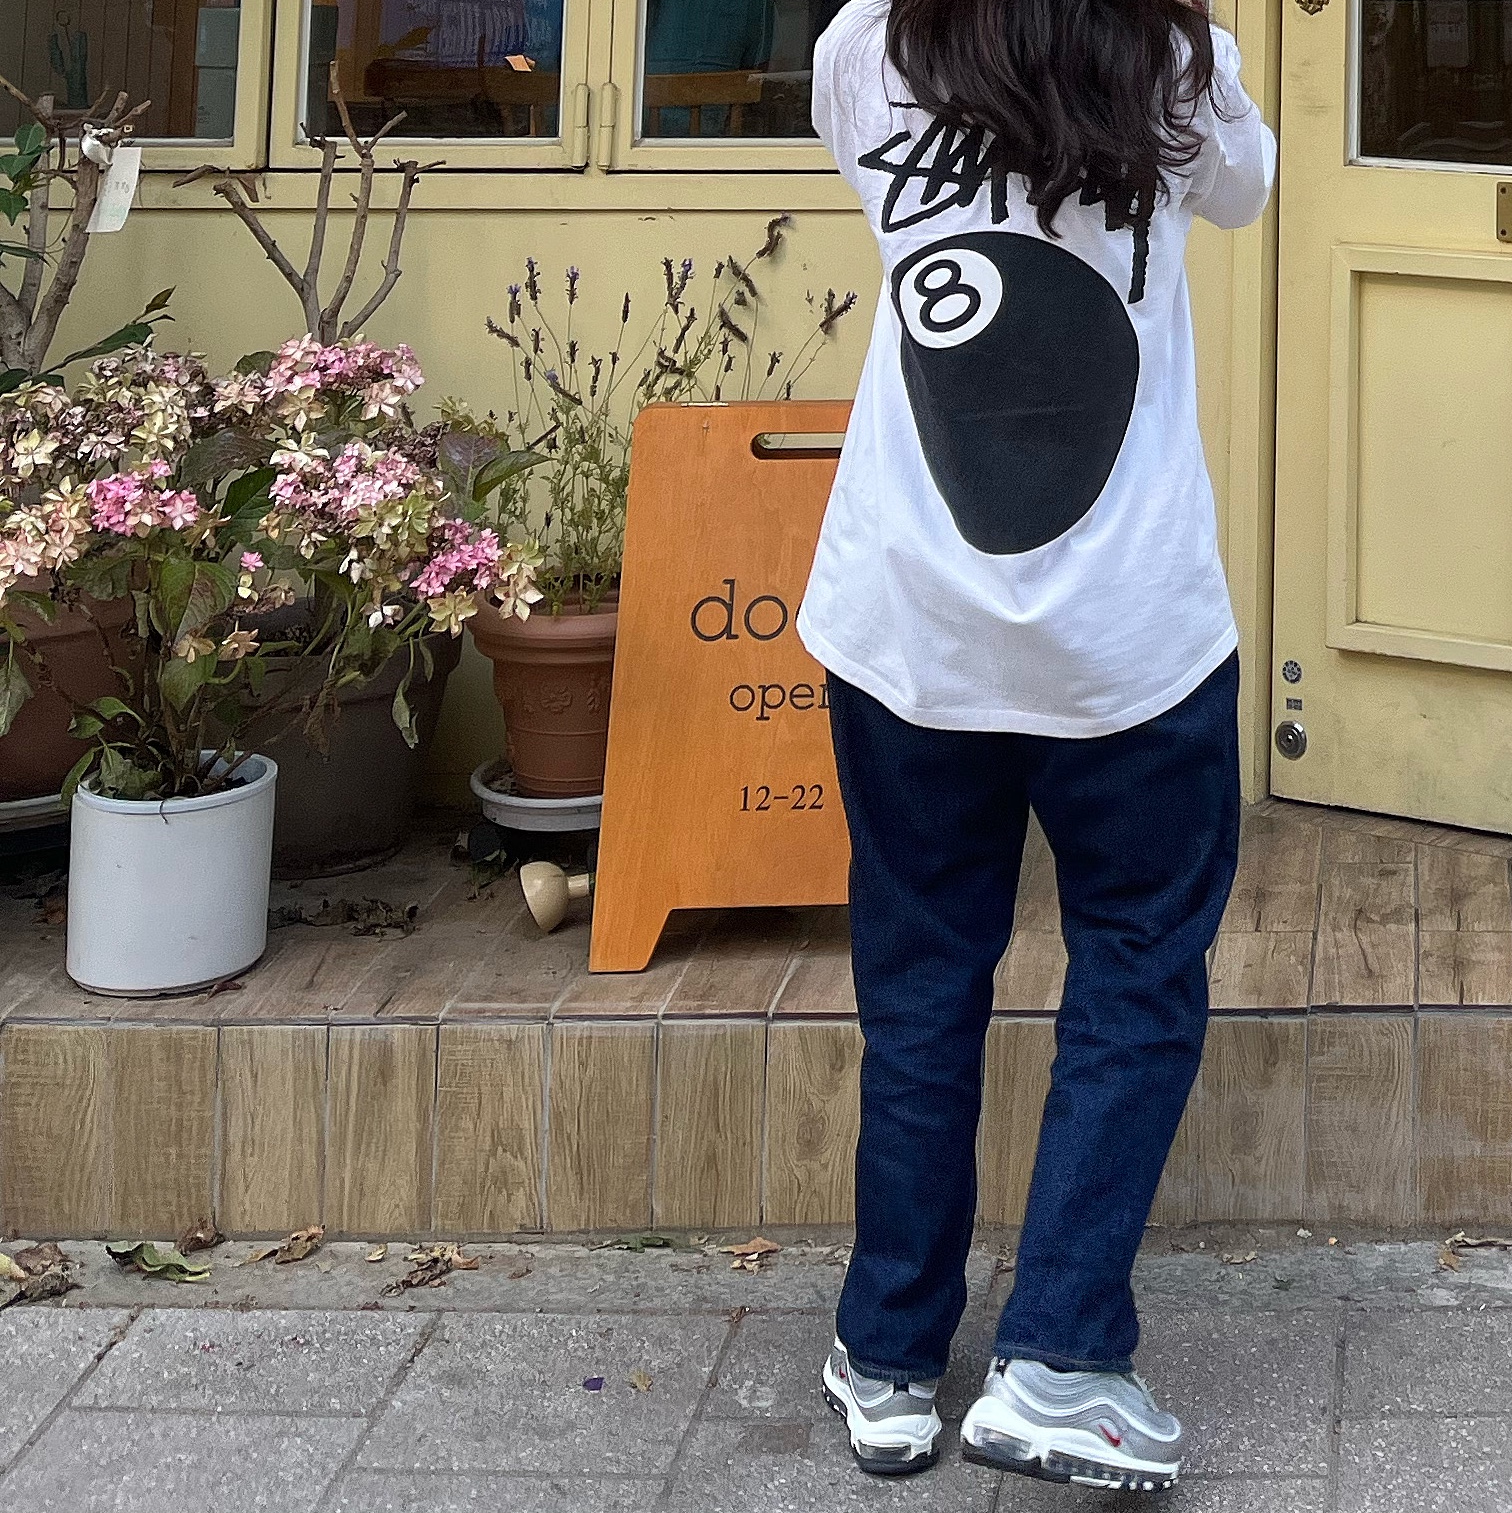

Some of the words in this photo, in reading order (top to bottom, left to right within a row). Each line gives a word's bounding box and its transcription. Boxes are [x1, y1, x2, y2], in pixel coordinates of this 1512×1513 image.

[914, 259, 981, 332] 8
[690, 578, 803, 642] do
[739, 784, 824, 812] 12-22
